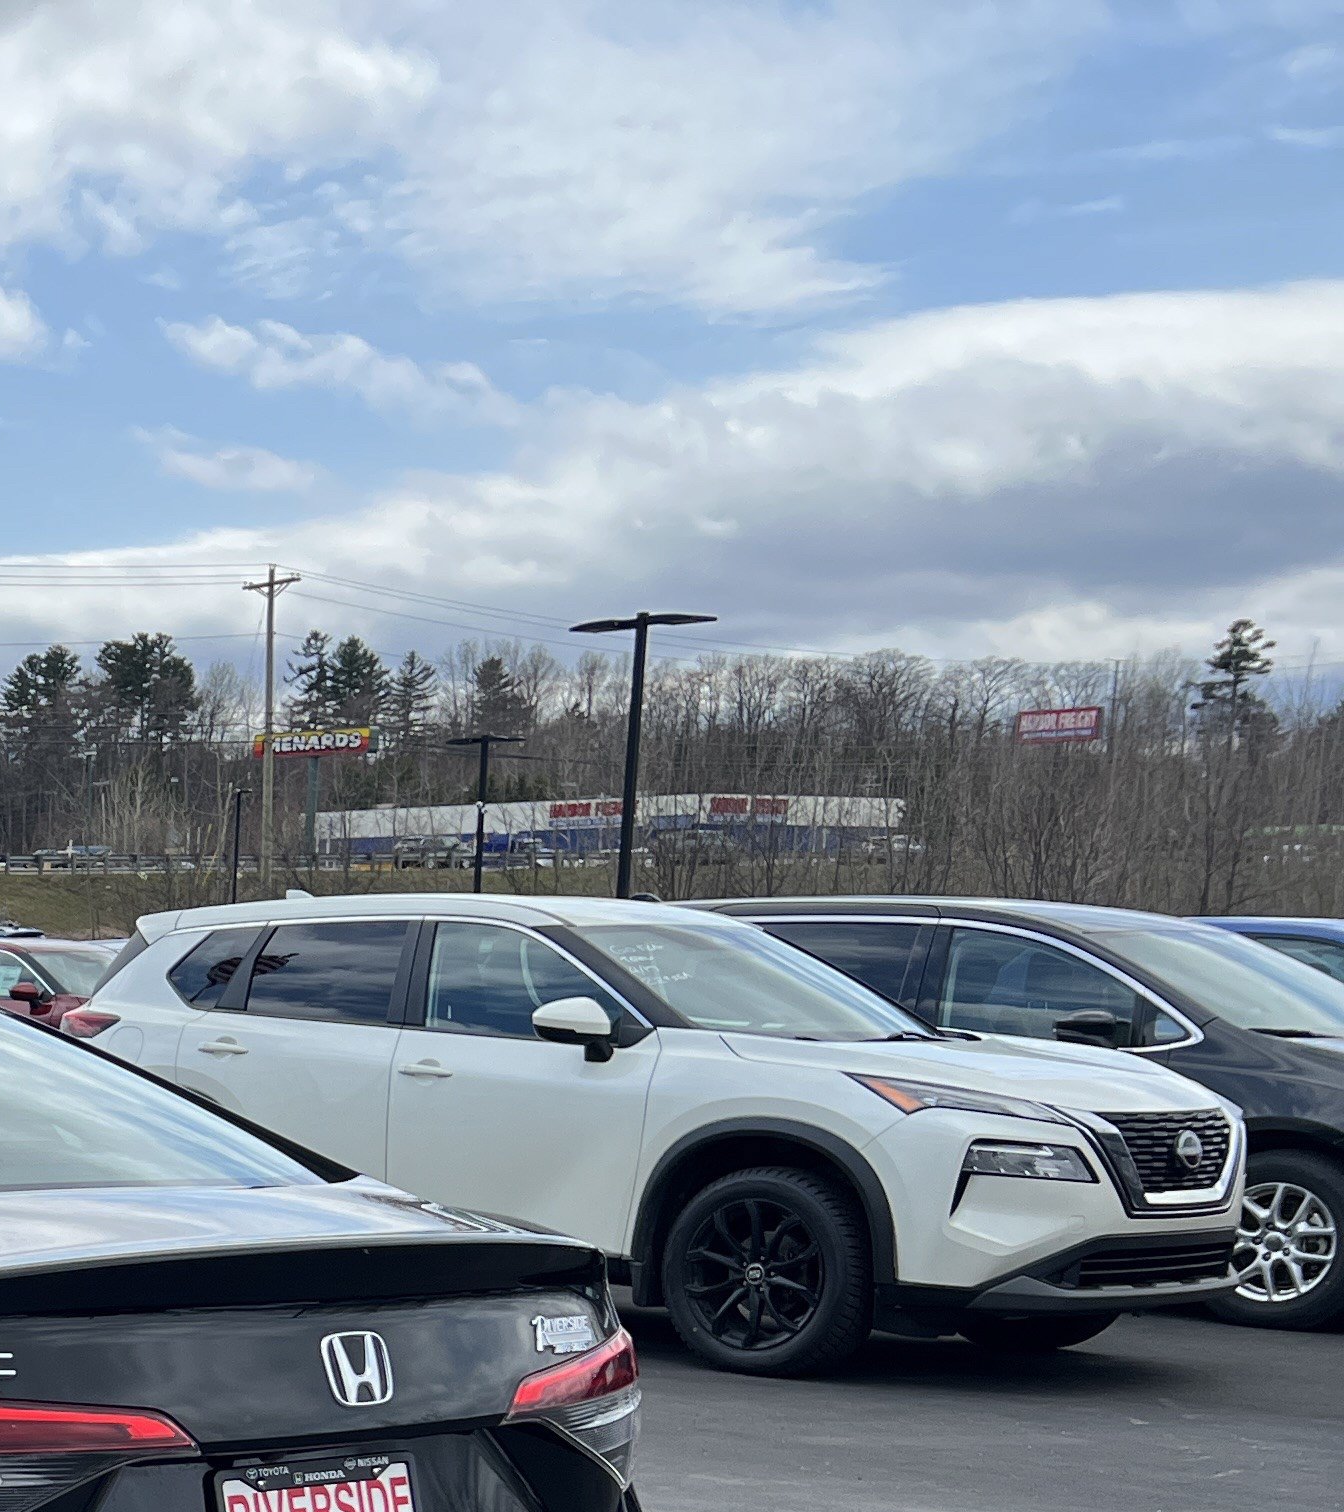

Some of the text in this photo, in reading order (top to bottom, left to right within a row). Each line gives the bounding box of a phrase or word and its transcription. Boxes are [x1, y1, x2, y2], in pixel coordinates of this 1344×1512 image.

[357, 1456, 390, 1467] NISSAN
[258, 1466, 291, 1477] TOYOTA
[304, 1469, 346, 1482] HONDA
